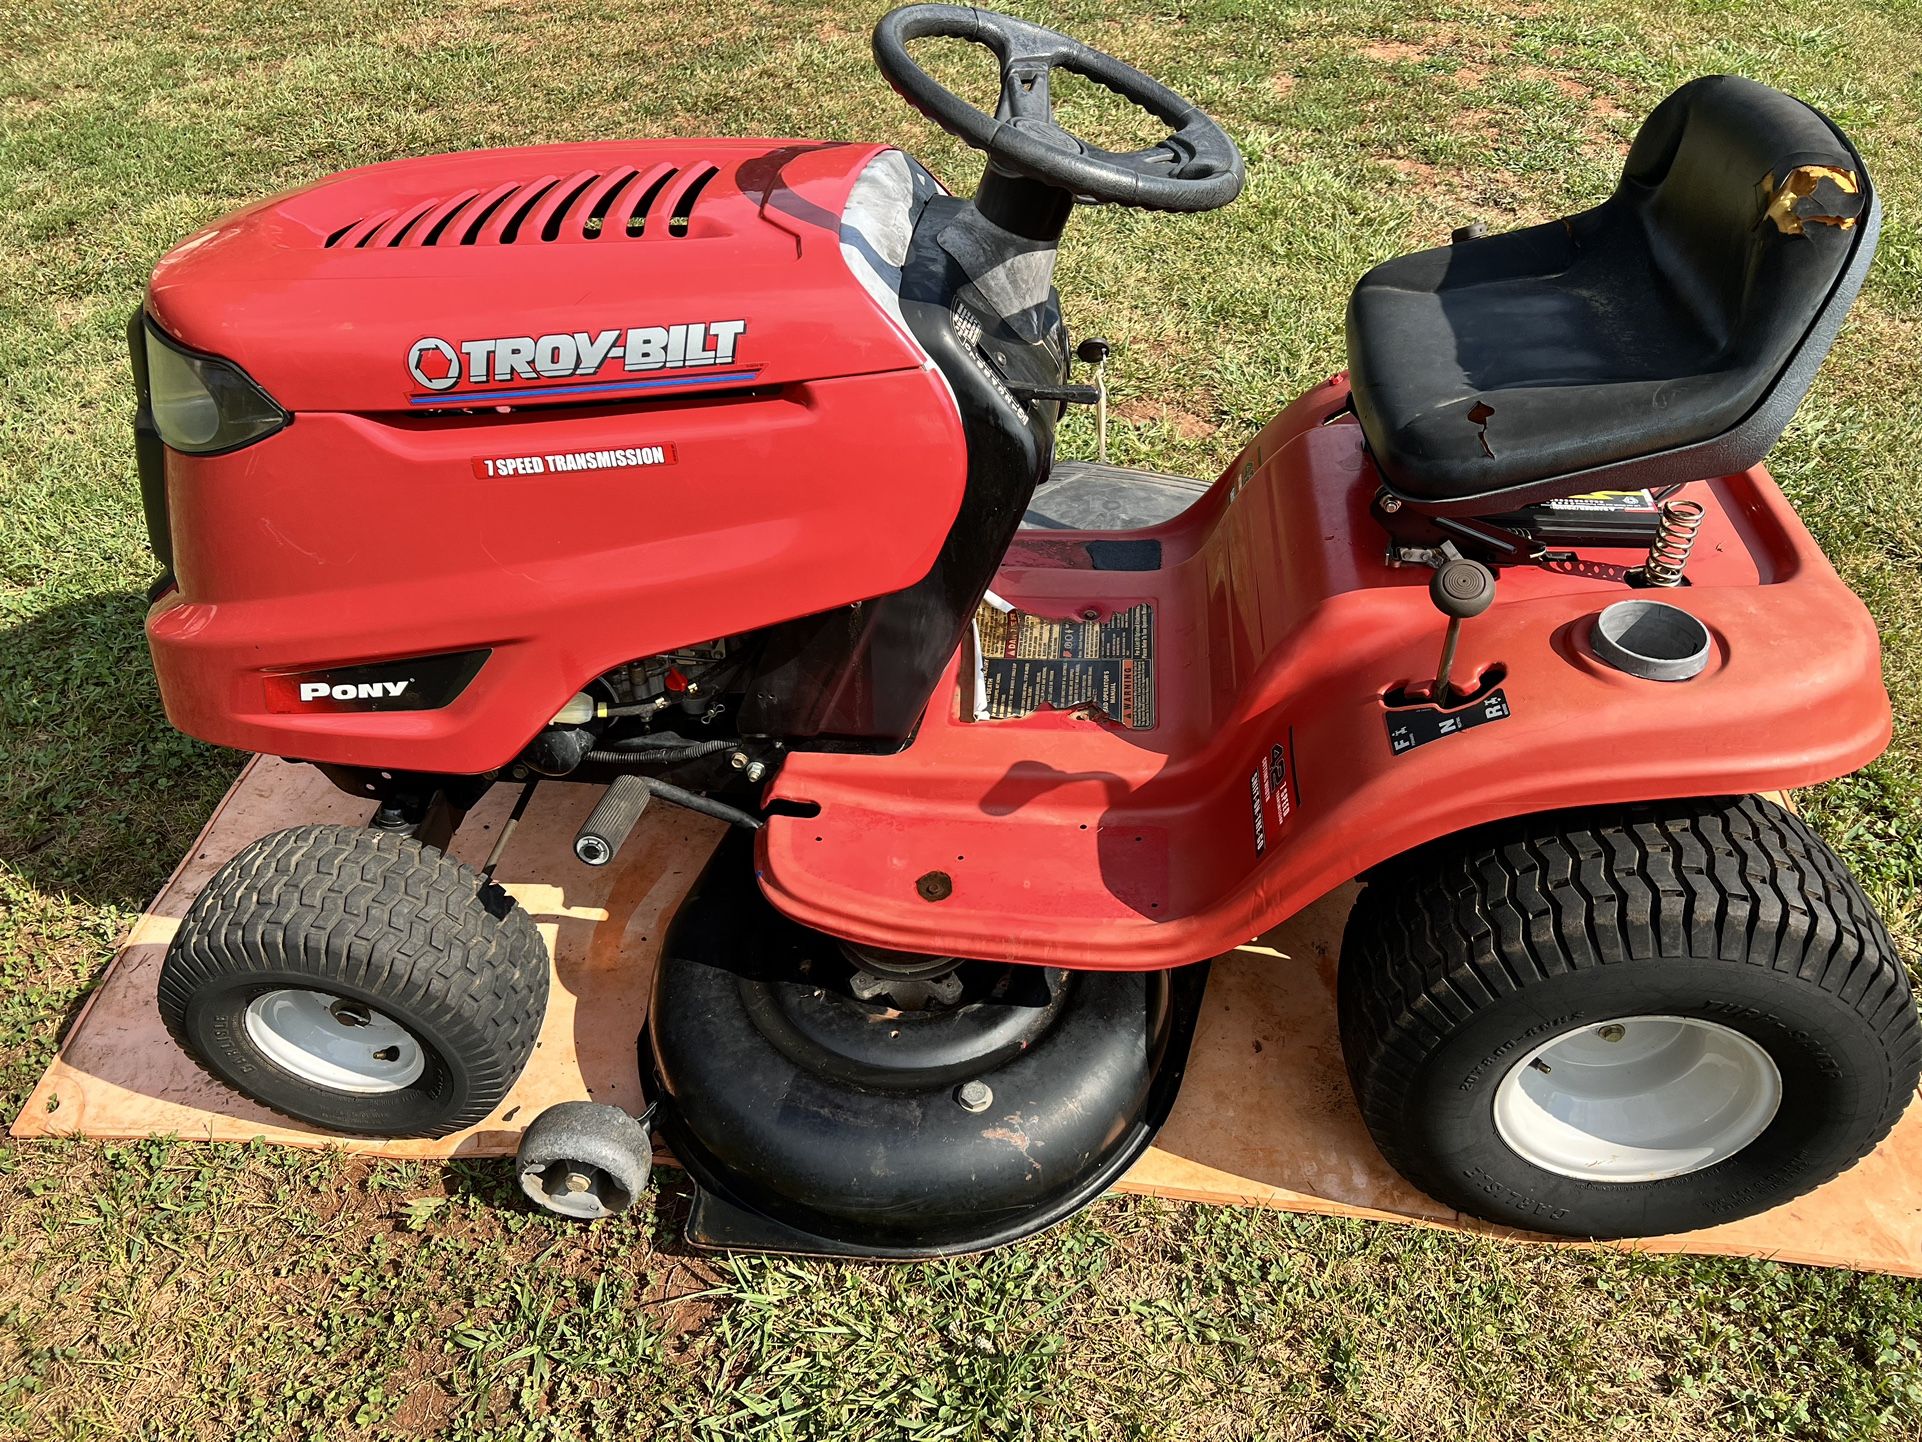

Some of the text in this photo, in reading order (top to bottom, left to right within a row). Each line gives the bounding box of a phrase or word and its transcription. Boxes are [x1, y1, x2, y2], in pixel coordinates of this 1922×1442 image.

[460, 319, 745, 382] TROY-BILT
[485, 460, 494, 476] 7
[496, 456, 544, 476] SPEED
[545, 446, 665, 473] TRANSMISSION
[300, 680, 409, 702] PONY
[1124, 668, 1132, 710] WARNING
[1439, 718, 1456, 734] N
[1485, 705, 1502, 719] R
[1394, 739, 1410, 751] F
[1281, 788, 1290, 817] SPEED
[213, 1014, 257, 1074] CARLISLE
